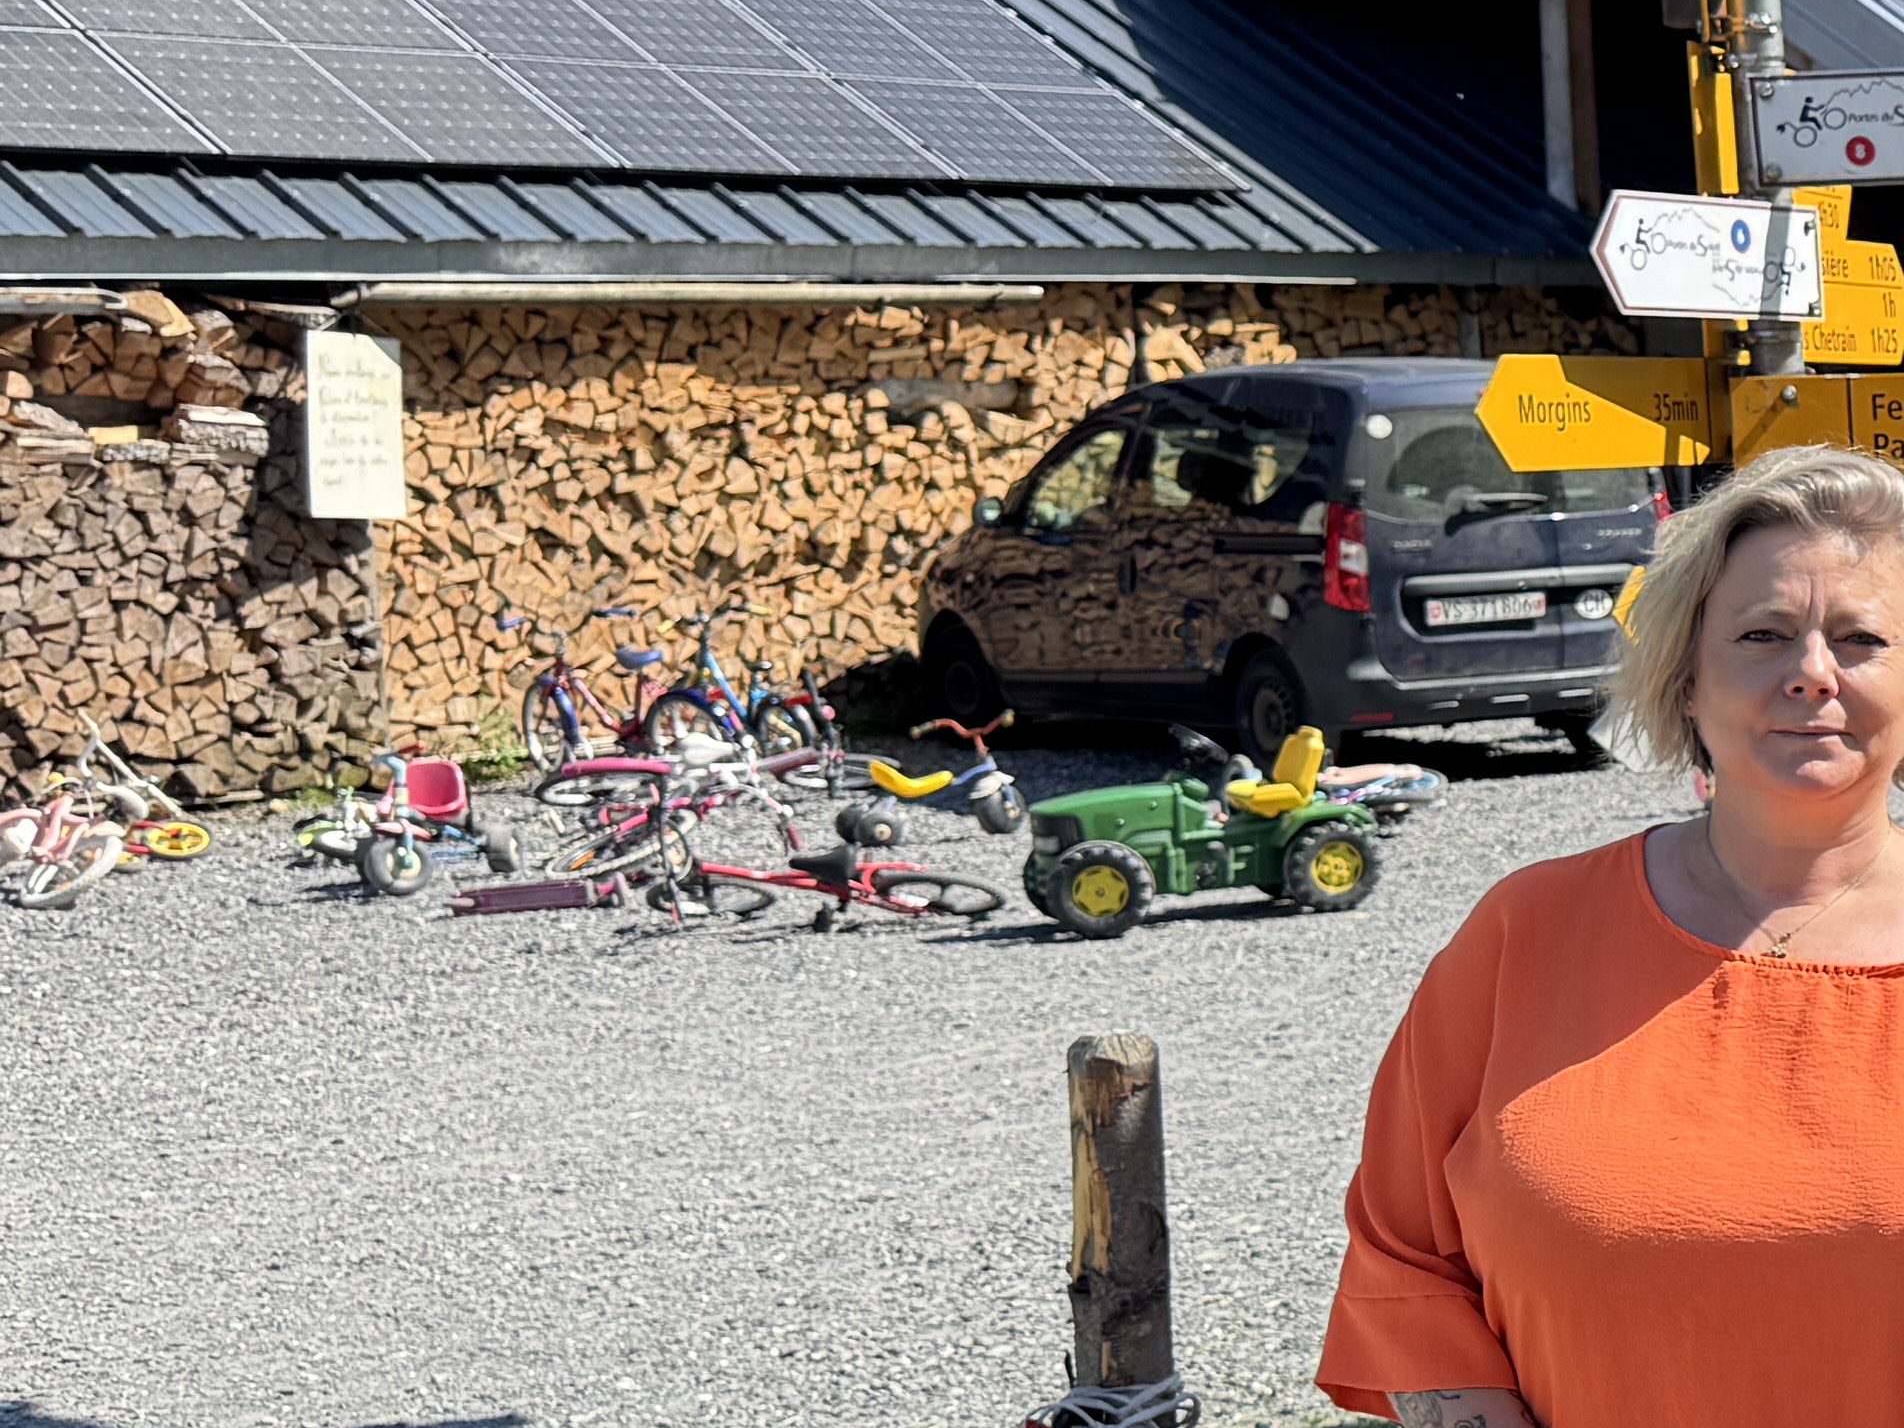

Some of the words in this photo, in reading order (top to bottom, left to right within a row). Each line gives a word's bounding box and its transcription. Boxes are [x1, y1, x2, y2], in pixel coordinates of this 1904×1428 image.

[1882, 292, 1896, 318] 1h
[1518, 392, 1592, 432] Morgins
[1653, 392, 1699, 422] 35min
